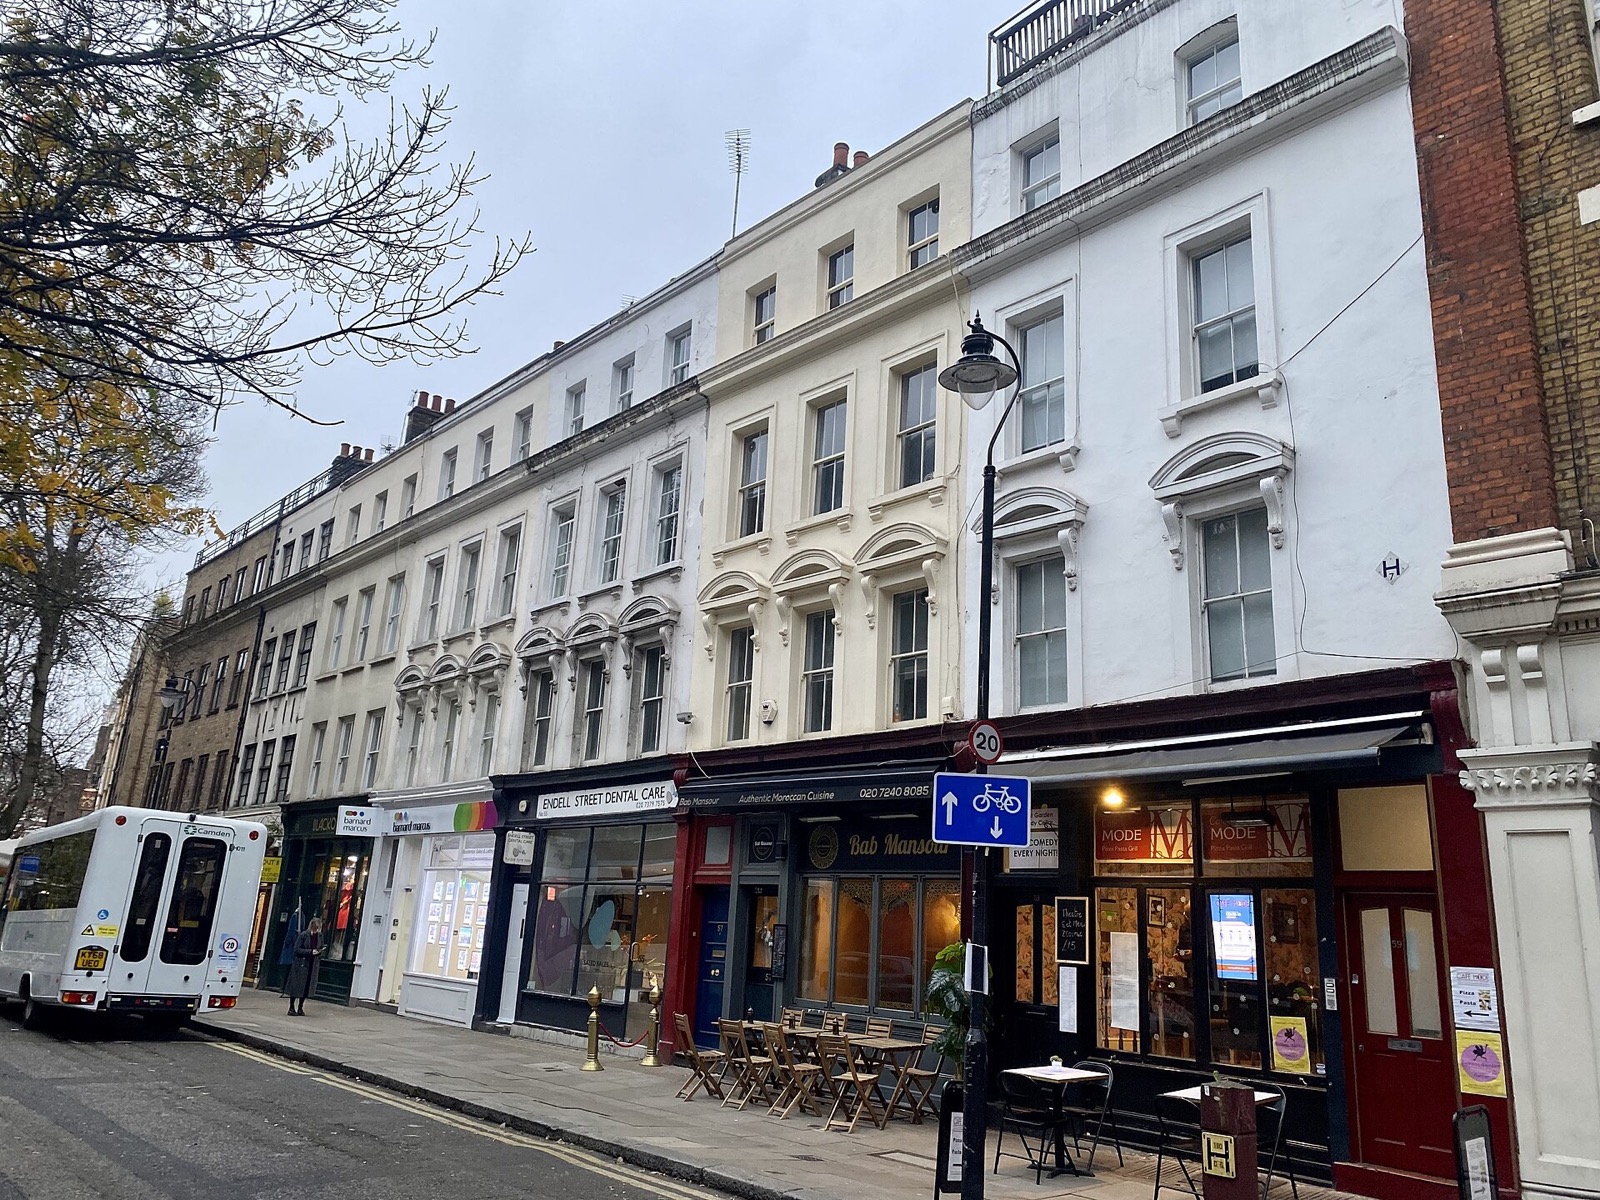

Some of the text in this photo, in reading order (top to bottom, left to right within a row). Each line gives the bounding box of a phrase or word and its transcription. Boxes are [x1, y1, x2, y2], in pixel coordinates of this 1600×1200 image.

[1382, 558, 1400, 578] H
[976, 732, 998, 752] 20
[542, 786, 666, 810] ENDELL STREET DENTAL CARE
[738, 790, 835, 804] Authentic Moroccan Cuisine
[860, 786, 929, 798] 020 7240 8085
[679, 797, 720, 806] Bab Mansour
[344, 817, 371, 826] barnard
[393, 821, 431, 832] barnard marcus
[198, 828, 230, 838] Camden
[1102, 830, 1142, 841] MODE
[1211, 827, 1256, 840] MODE
[849, 834, 878, 856] Bab
[1062, 939, 1076, 951] £15
[1392, 940, 1402, 948] 59
[1207, 1137, 1230, 1173] H
